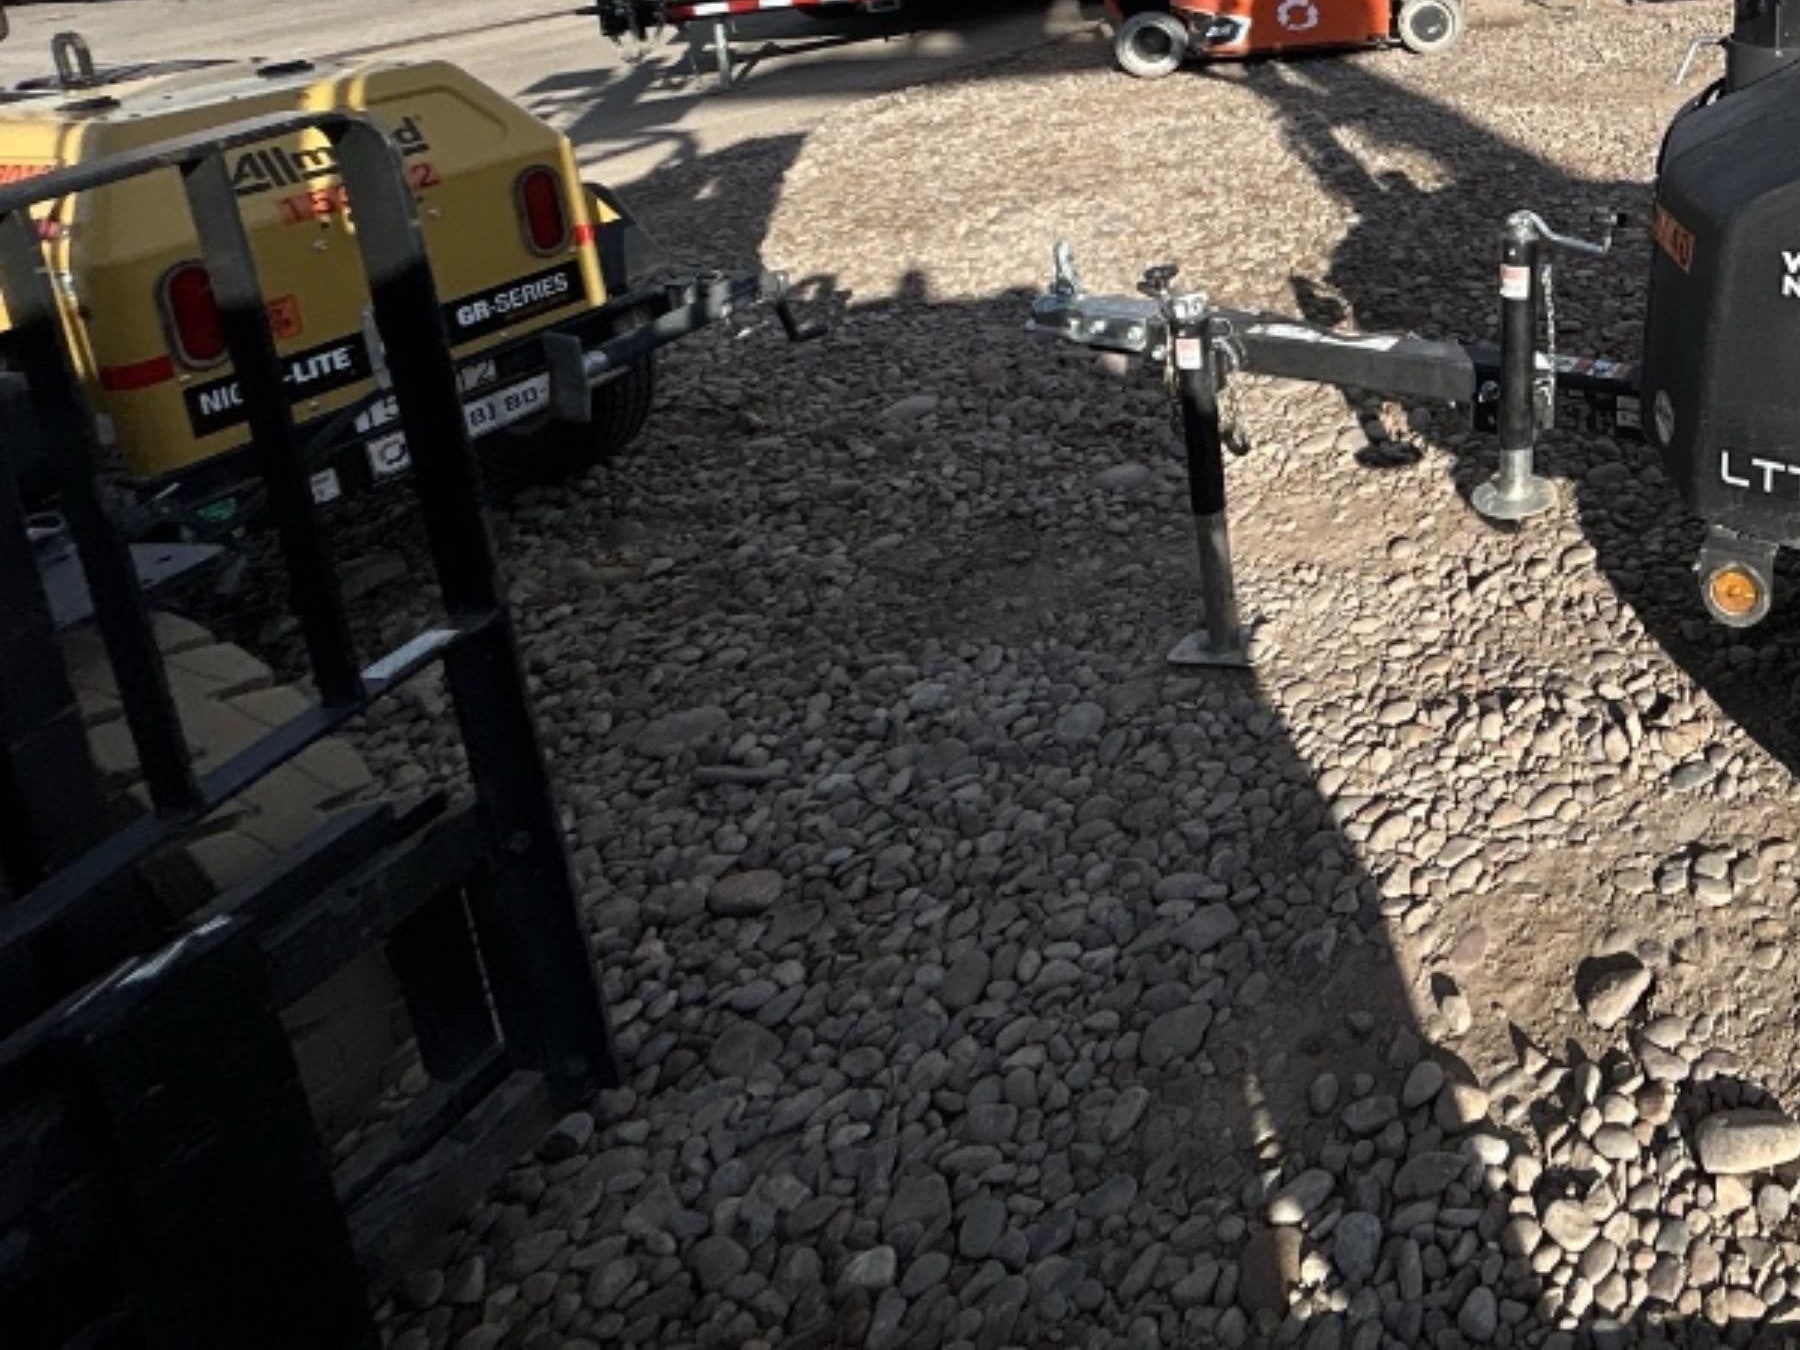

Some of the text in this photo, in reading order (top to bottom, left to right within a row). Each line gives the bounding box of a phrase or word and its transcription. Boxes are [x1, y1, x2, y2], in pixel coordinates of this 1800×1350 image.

[232, 116, 427, 190] Allmd
[456, 271, 569, 327] GR-SERIES
[198, 346, 352, 415] NIG-LITE
